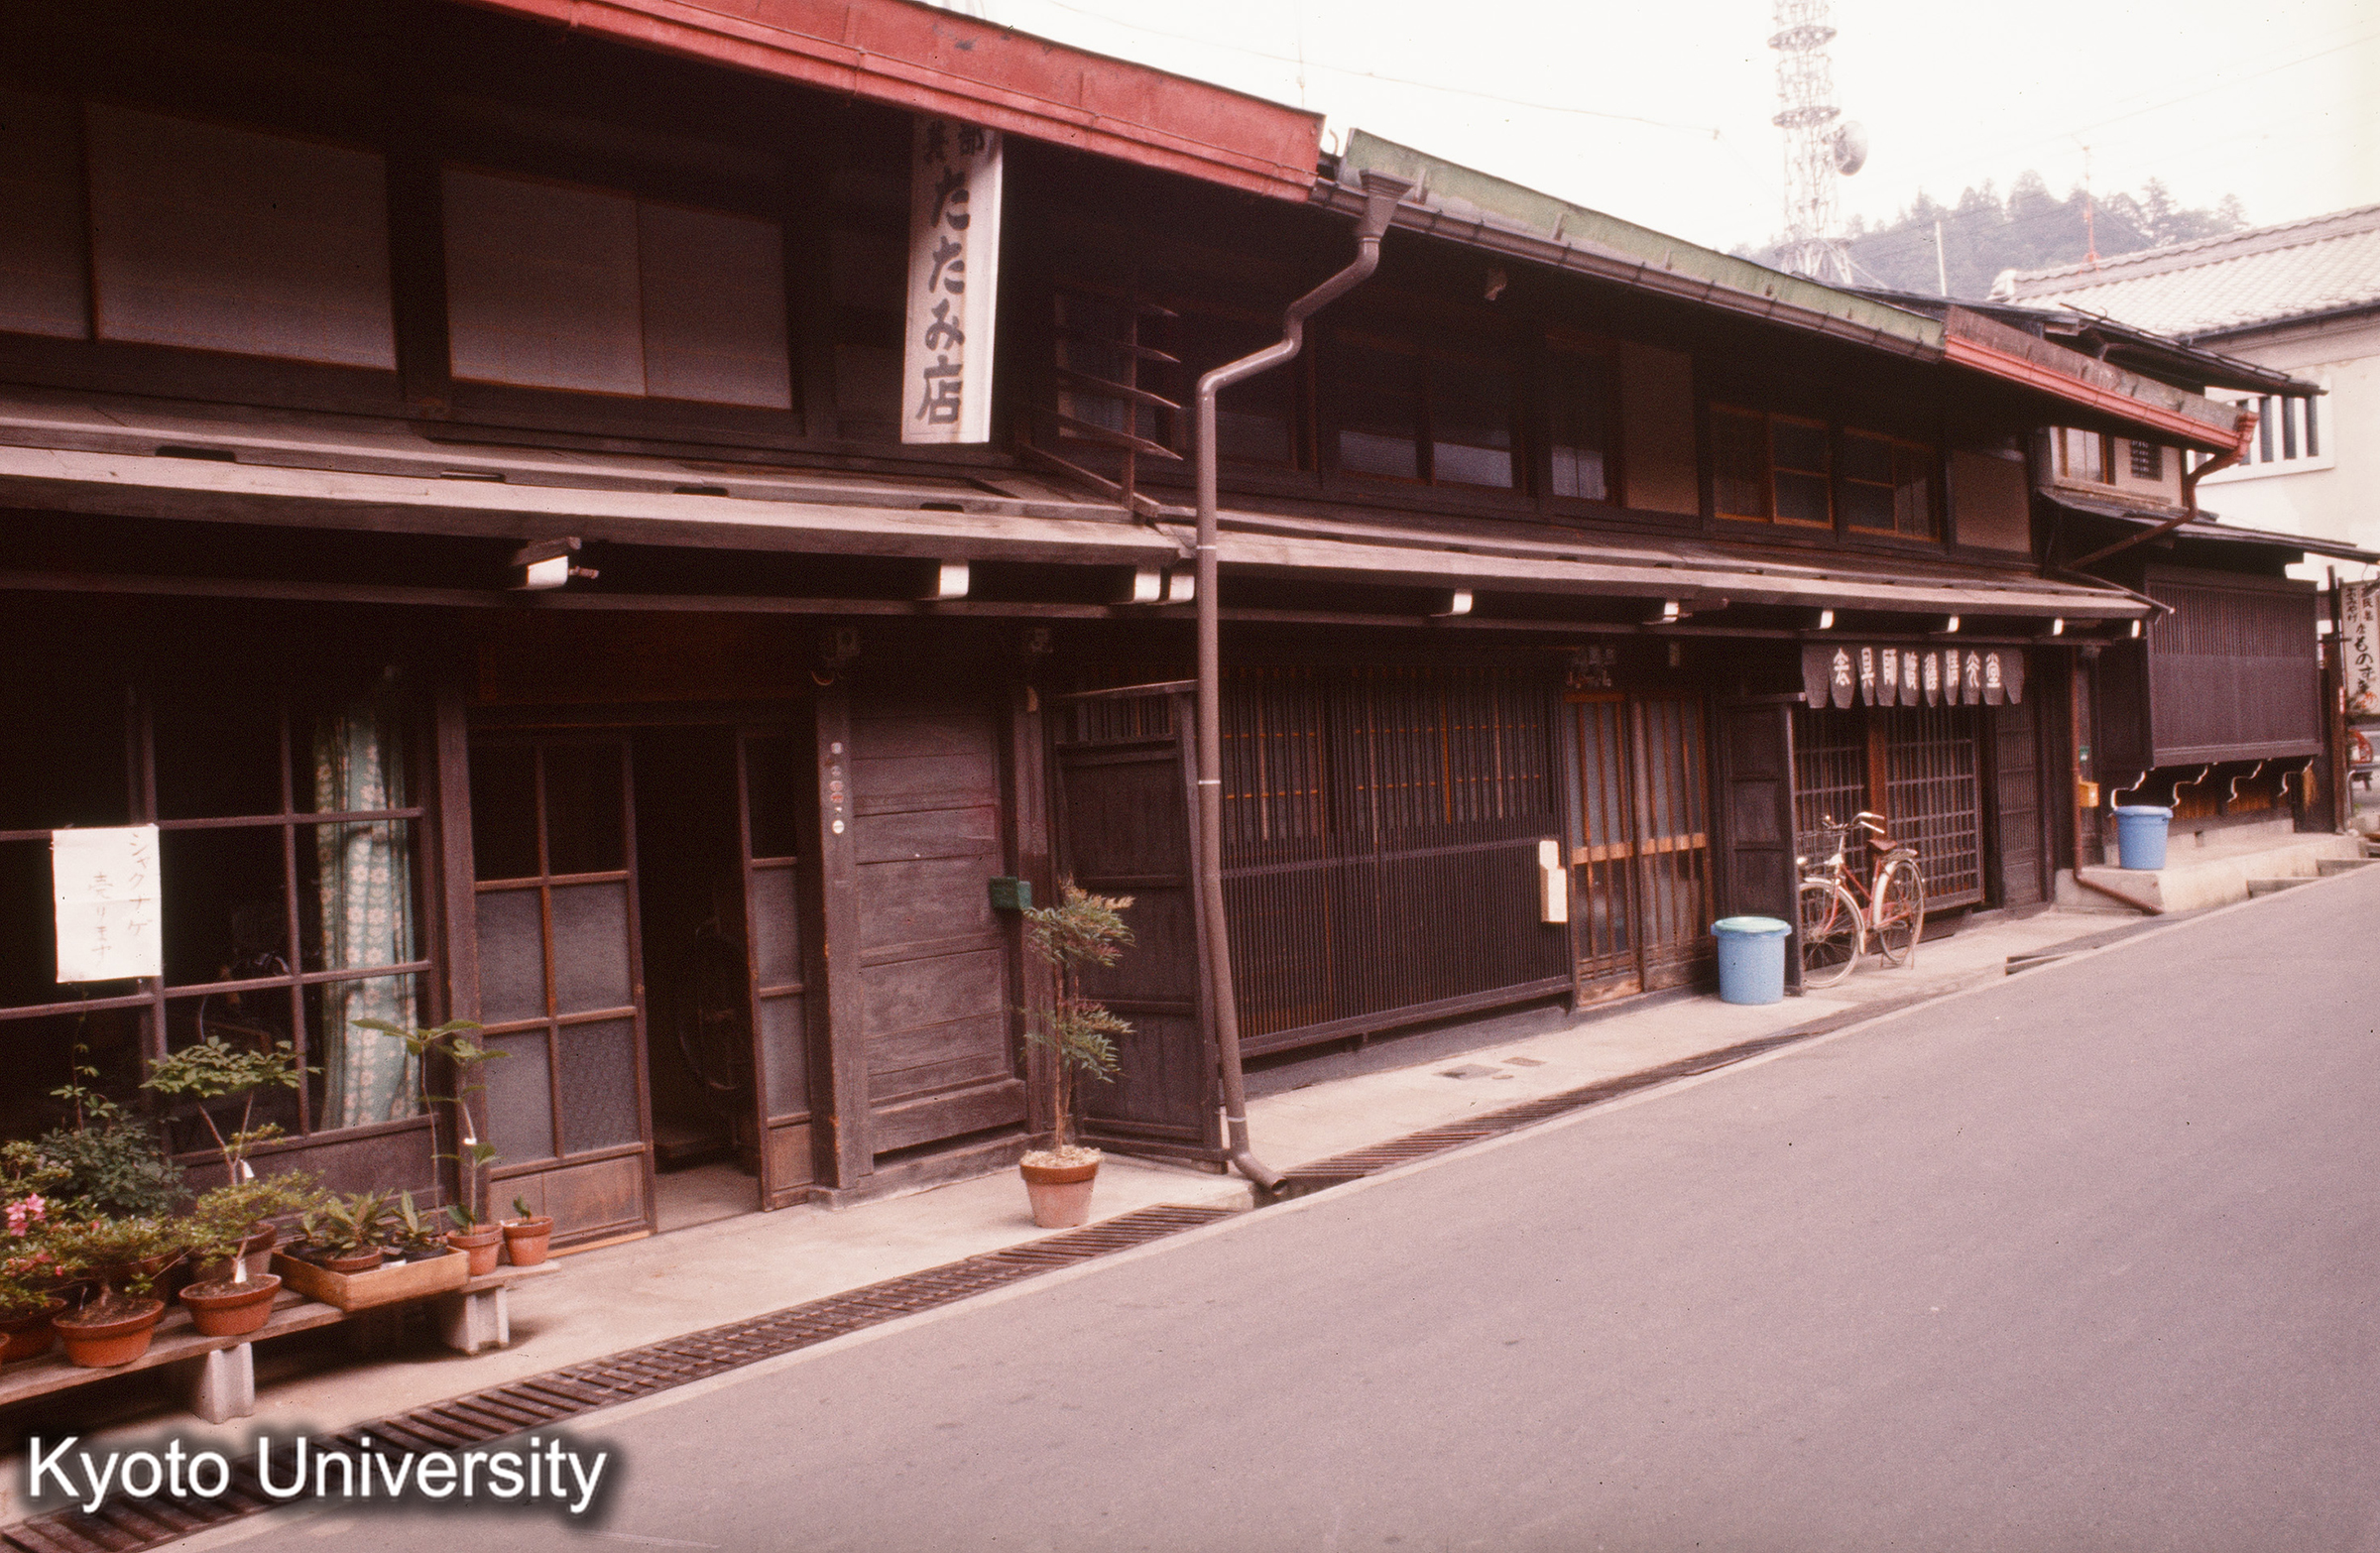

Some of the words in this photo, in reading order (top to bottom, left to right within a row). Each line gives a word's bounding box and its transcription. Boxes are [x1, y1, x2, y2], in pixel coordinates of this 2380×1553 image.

[914, 165, 972, 426] たたみ店
[88, 871, 114, 967] 売ります
[127, 833, 153, 937] シャクナゲ
